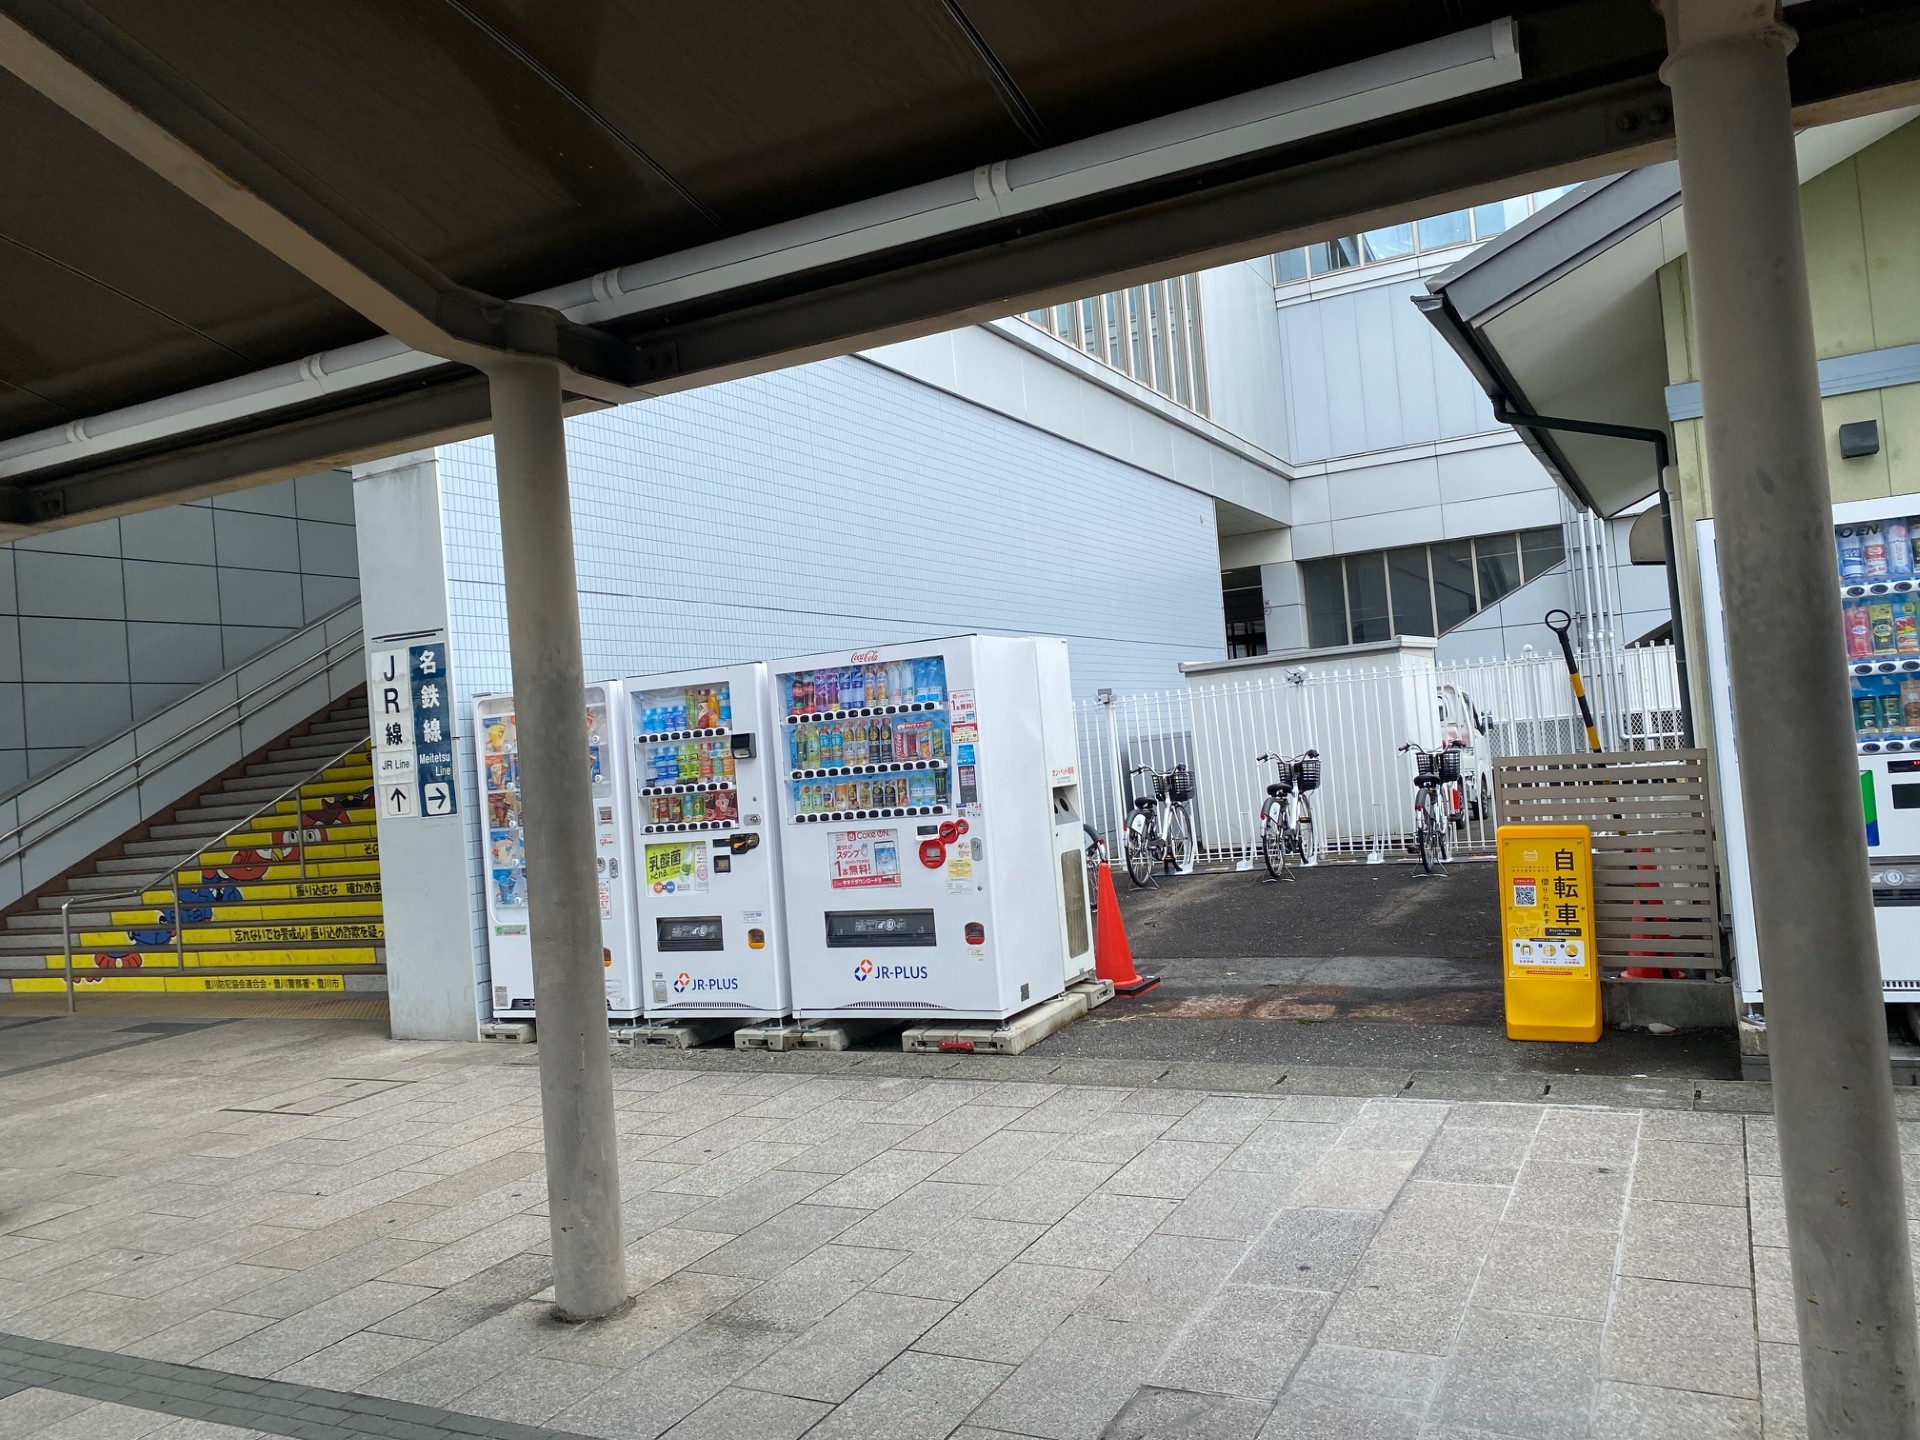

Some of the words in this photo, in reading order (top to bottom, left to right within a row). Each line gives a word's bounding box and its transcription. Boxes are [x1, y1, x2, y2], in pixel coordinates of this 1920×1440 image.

[383, 655, 403, 746] JR線
[419, 650, 442, 744] 名鉄線
[419, 752, 450, 764] Meitetsu
[382, 760, 392, 770] JR
[394, 759, 410, 770] Line
[435, 765, 451, 776] Line
[856, 831, 876, 840] Coke
[837, 849, 860, 859] スタンプ
[649, 849, 681, 872] 乳酸菌
[1553, 848, 1580, 926] 自転車
[1541, 878, 1550, 925] 借りられます
[875, 966, 928, 979] JR-PLUS
[692, 978, 738, 990] JR-PLUS
